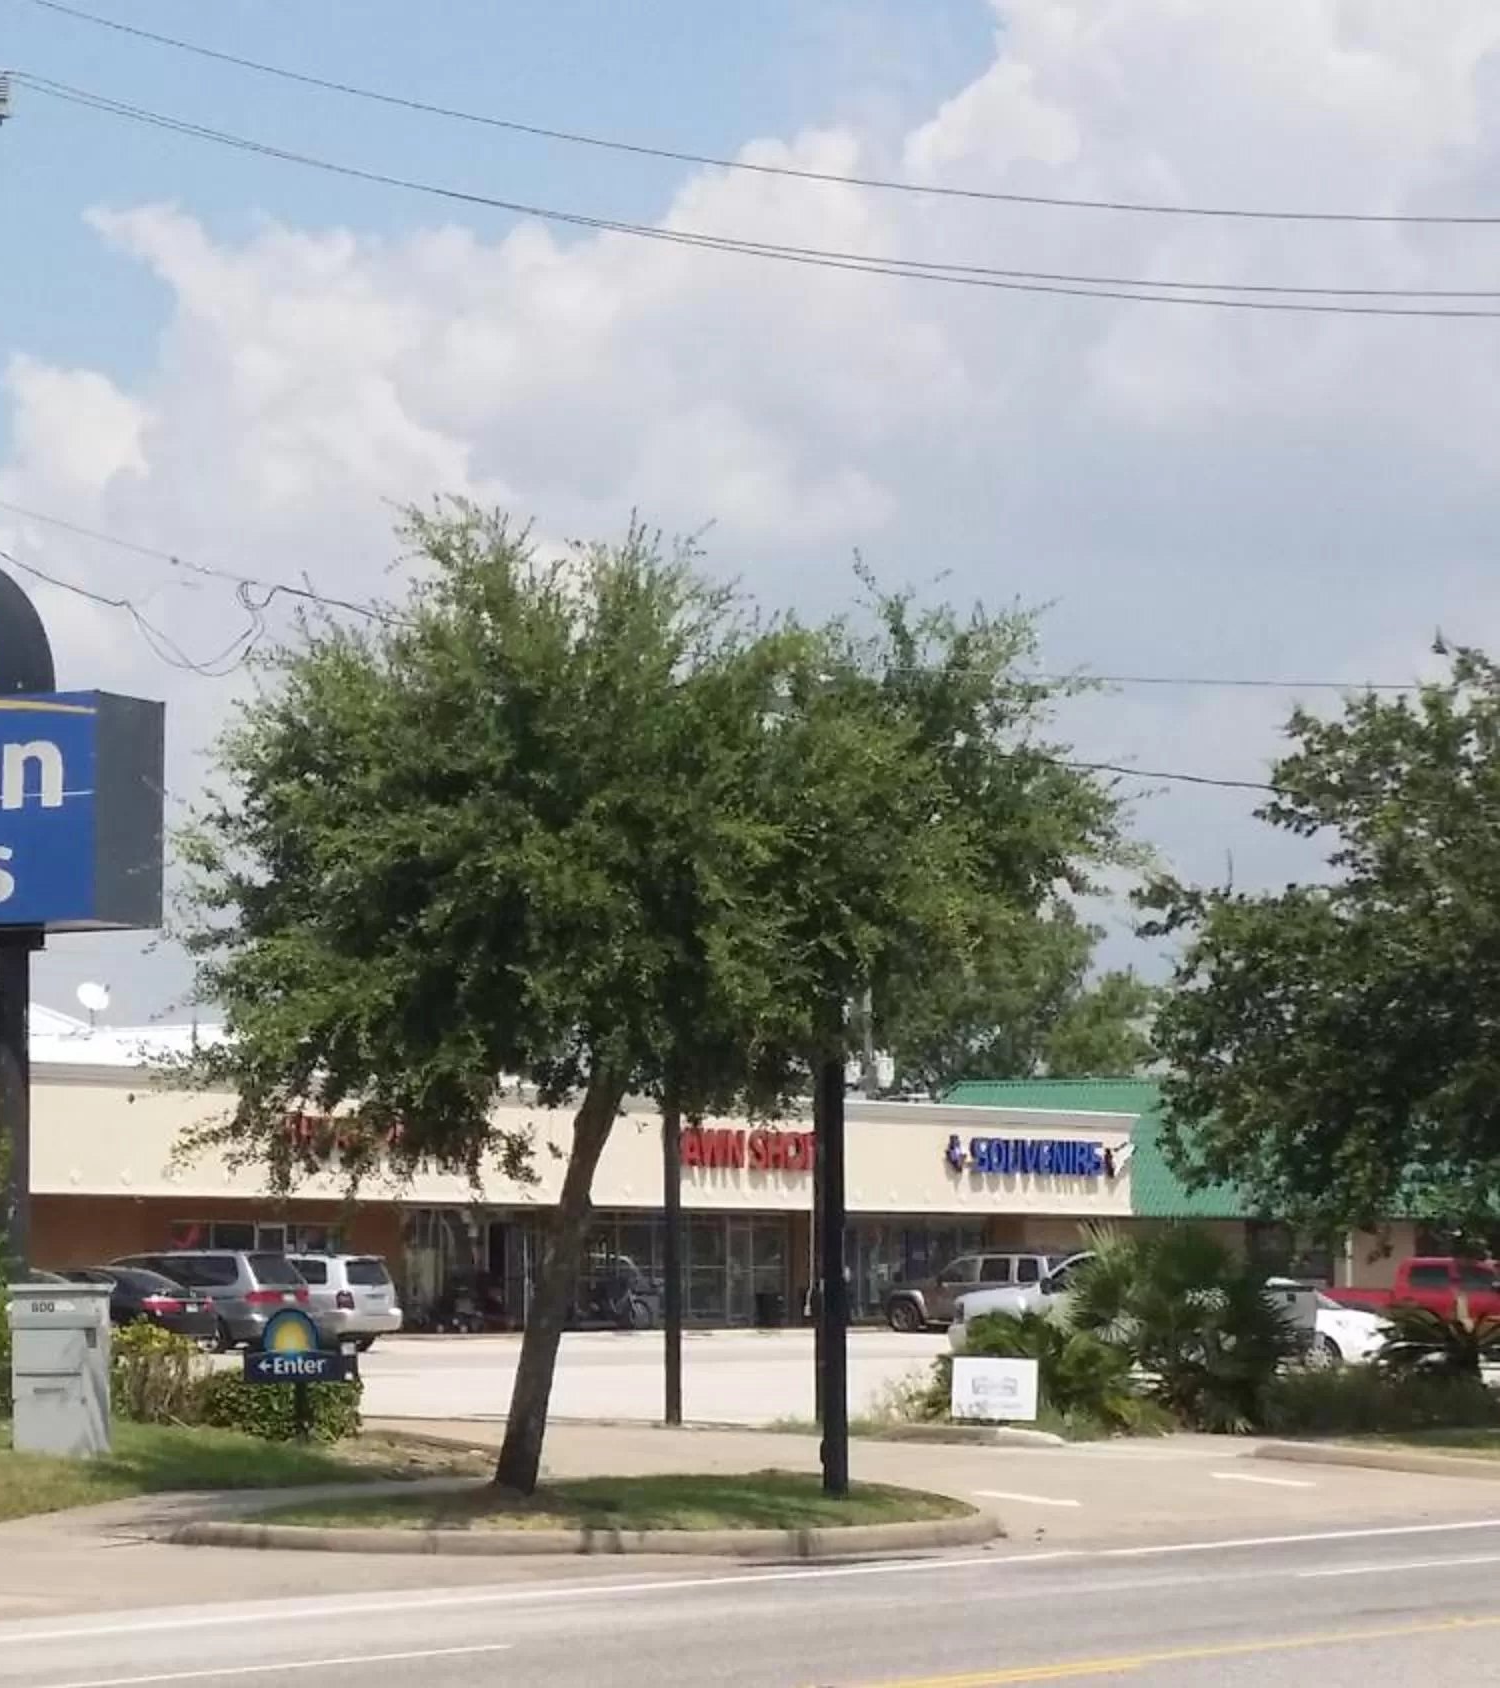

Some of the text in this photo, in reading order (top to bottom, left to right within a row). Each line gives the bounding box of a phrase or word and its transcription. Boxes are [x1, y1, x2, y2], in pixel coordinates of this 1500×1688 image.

[681, 1127, 745, 1169] AWN
[970, 1137, 1105, 1176] SOUVENIRS
[273, 1356, 328, 1375] Enter
